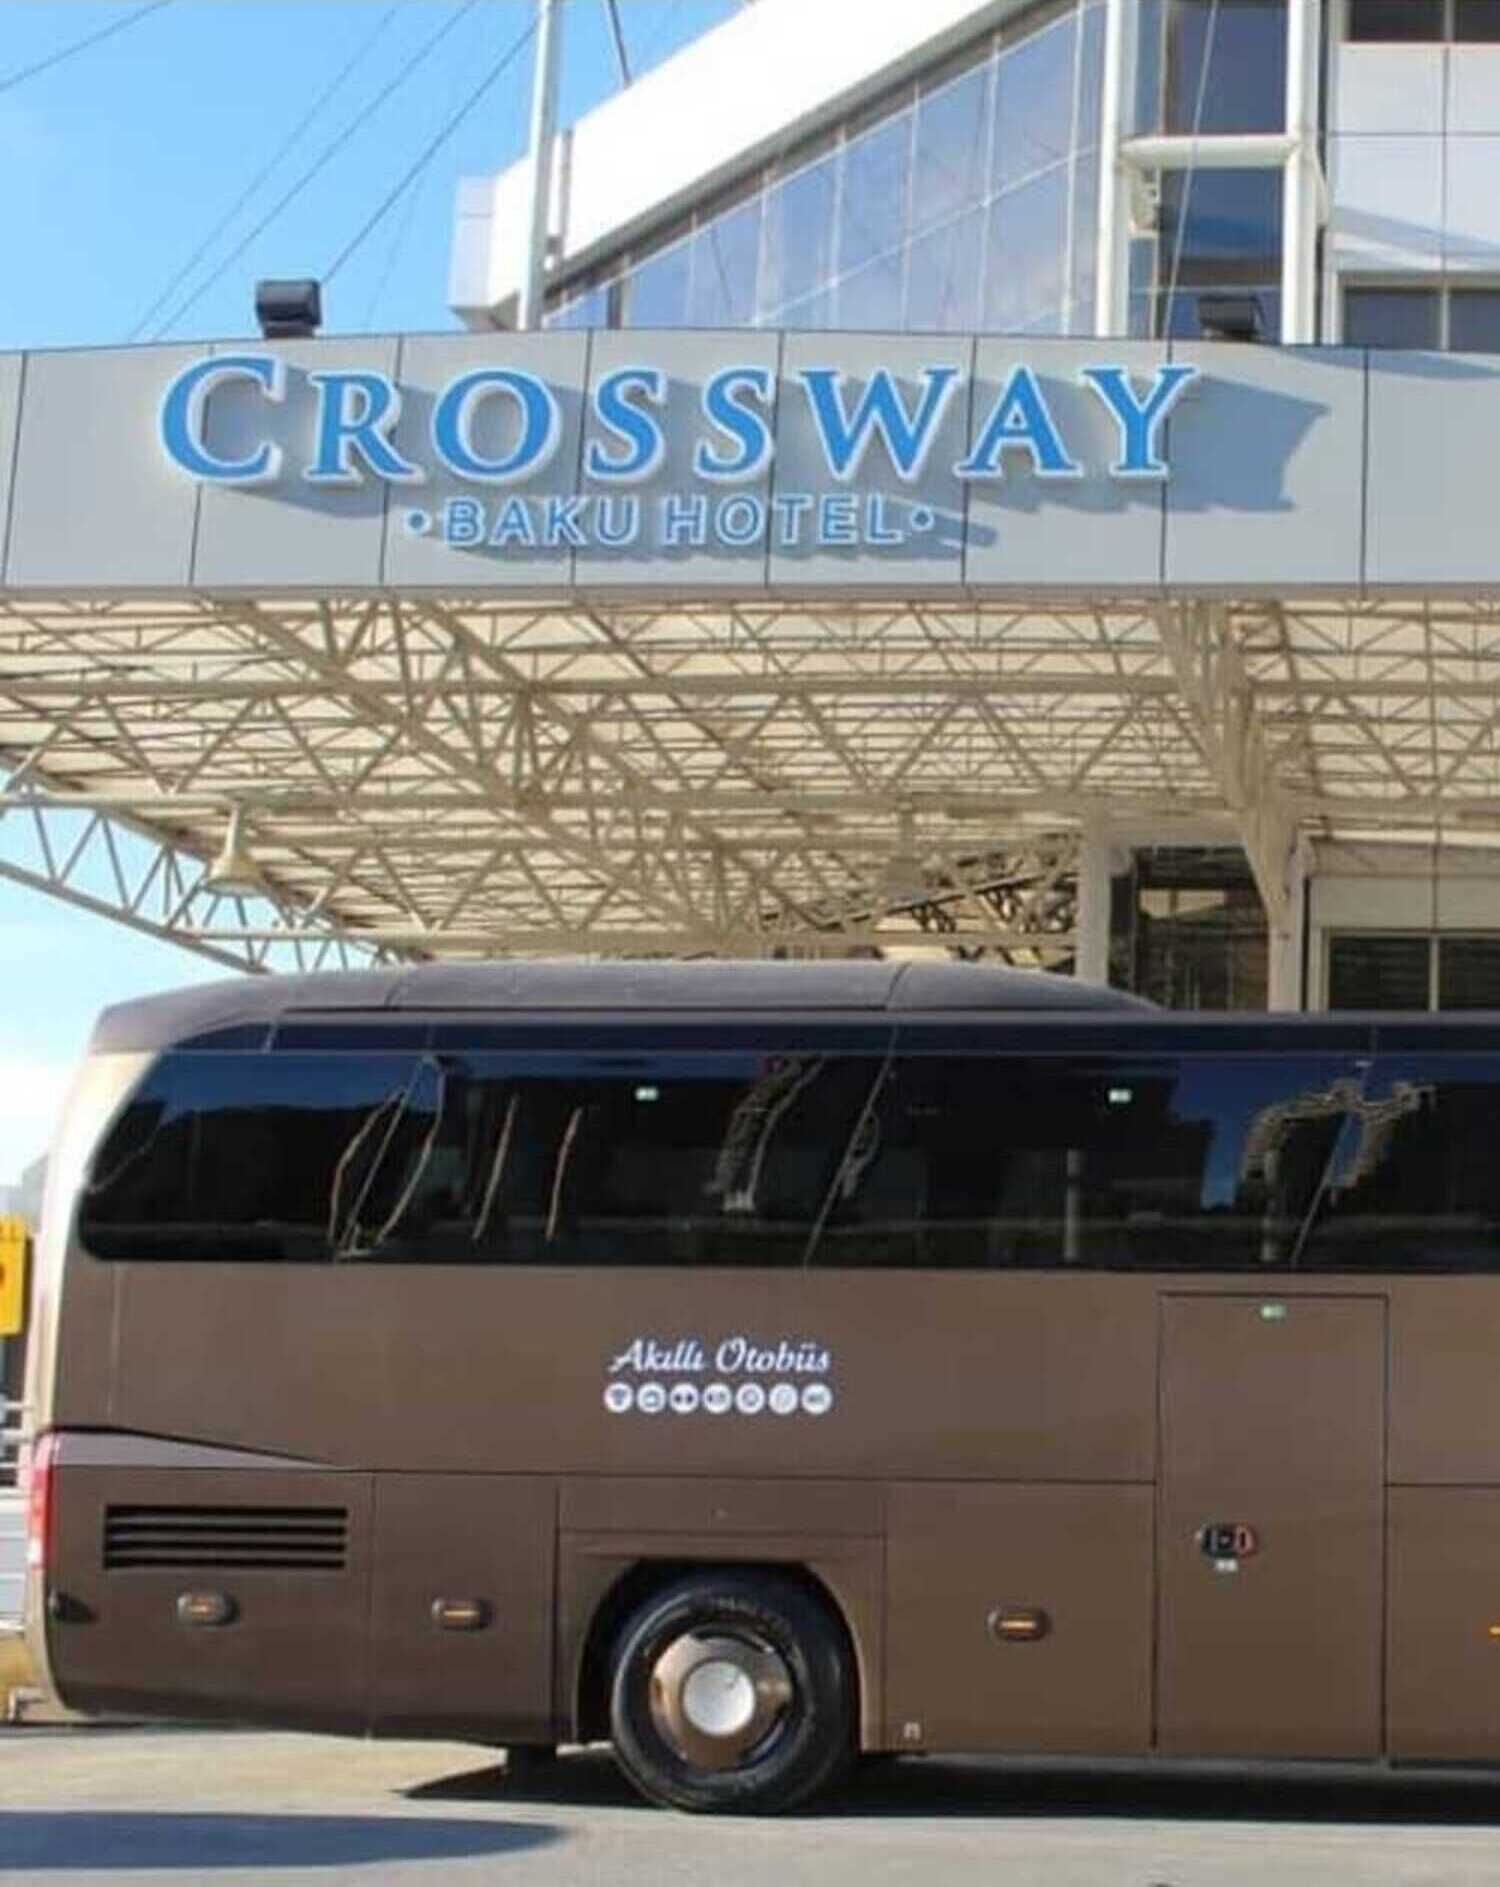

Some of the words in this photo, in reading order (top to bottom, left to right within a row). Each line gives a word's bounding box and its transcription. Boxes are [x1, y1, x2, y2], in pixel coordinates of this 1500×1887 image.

[160, 353, 1196, 482] CROSSWAY
[444, 498, 633, 545] BAKU
[665, 495, 902, 547] HOTEL
[715, 1337, 832, 1373] Otobüs
